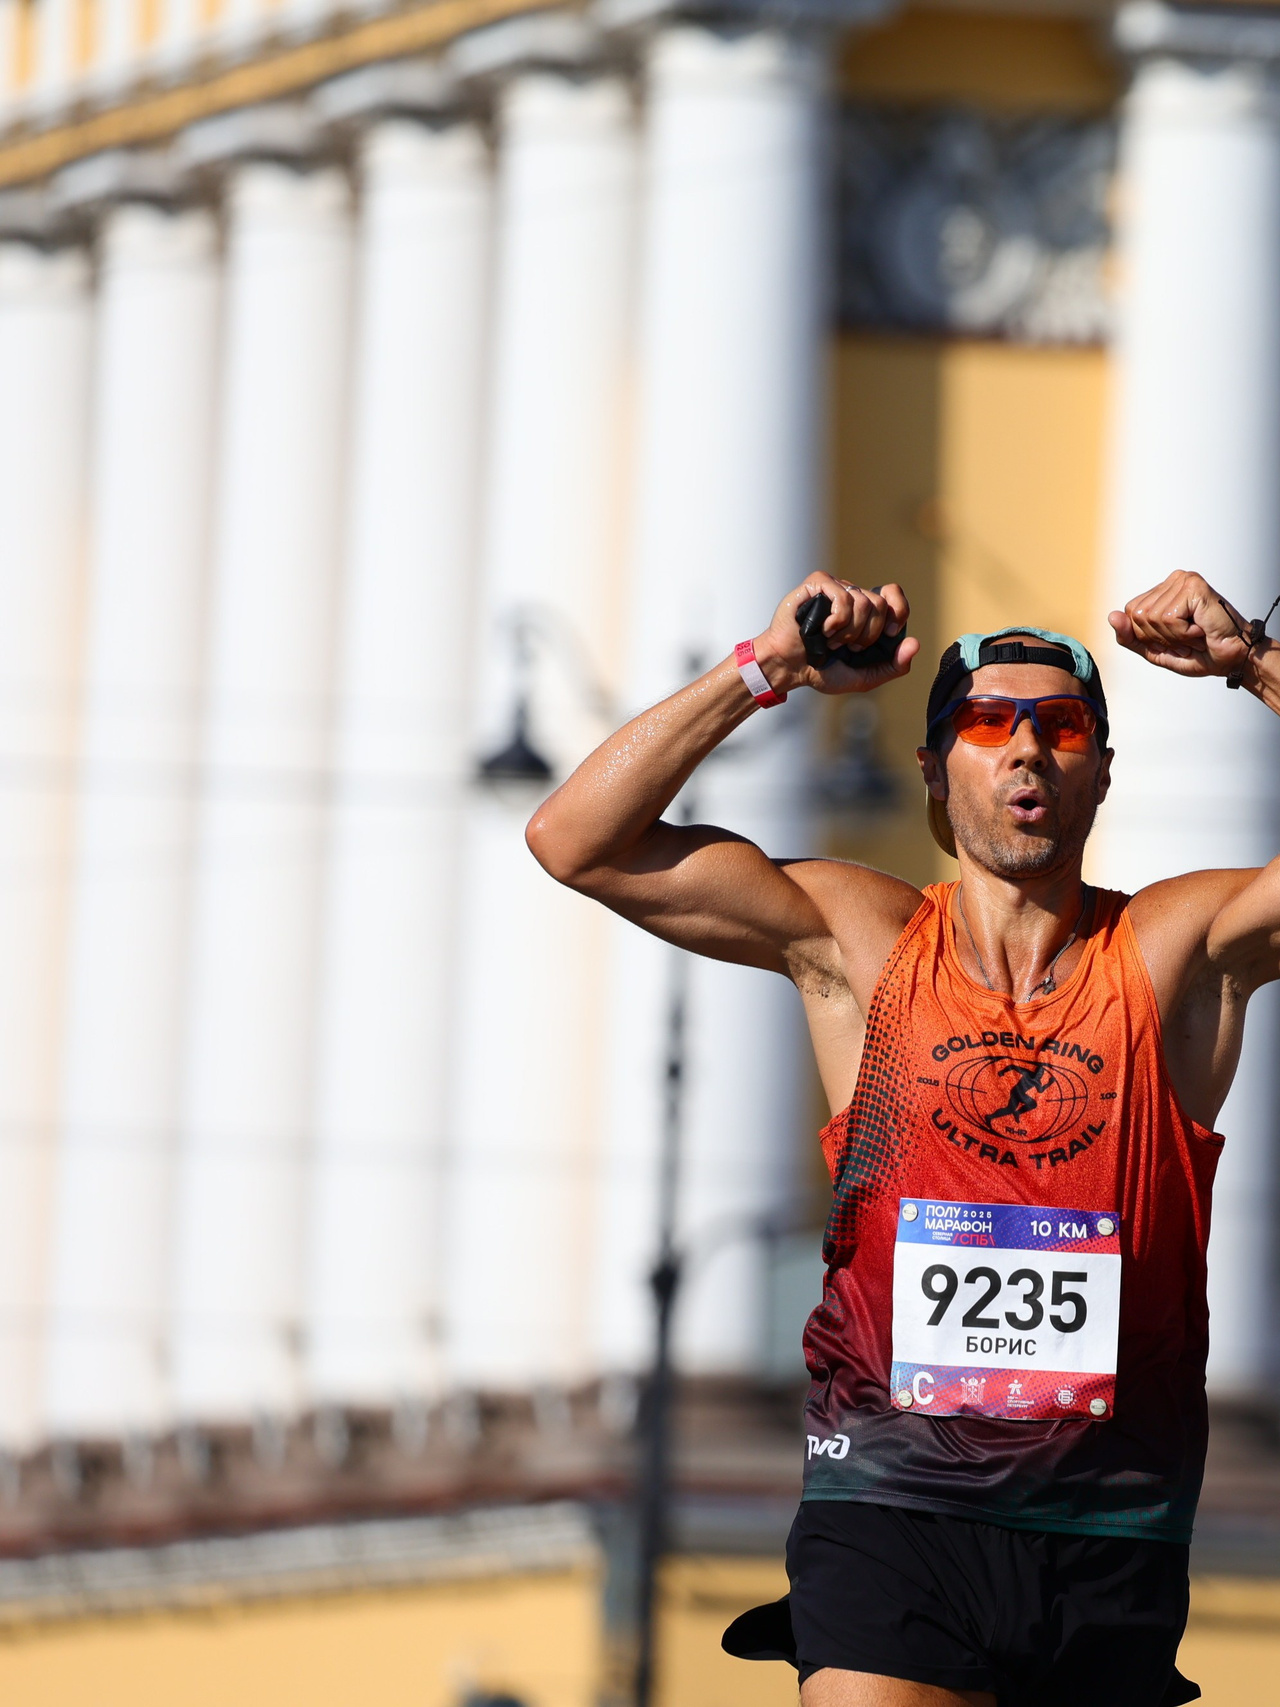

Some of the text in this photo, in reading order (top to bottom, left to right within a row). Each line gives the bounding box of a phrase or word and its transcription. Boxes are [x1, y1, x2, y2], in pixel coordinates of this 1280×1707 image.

[931, 1031, 1105, 1075] GOLDEN RING
[931, 1107, 1107, 1170] ULTRA TRAIL
[926, 1204, 992, 1219] ПОЛУ 2025
[925, 1217, 992, 1233] МАРАФОН
[1030, 1220, 1052, 1237] 10
[921, 1263, 1088, 1334] 9235
[965, 1335, 1038, 1356] БОРИС
